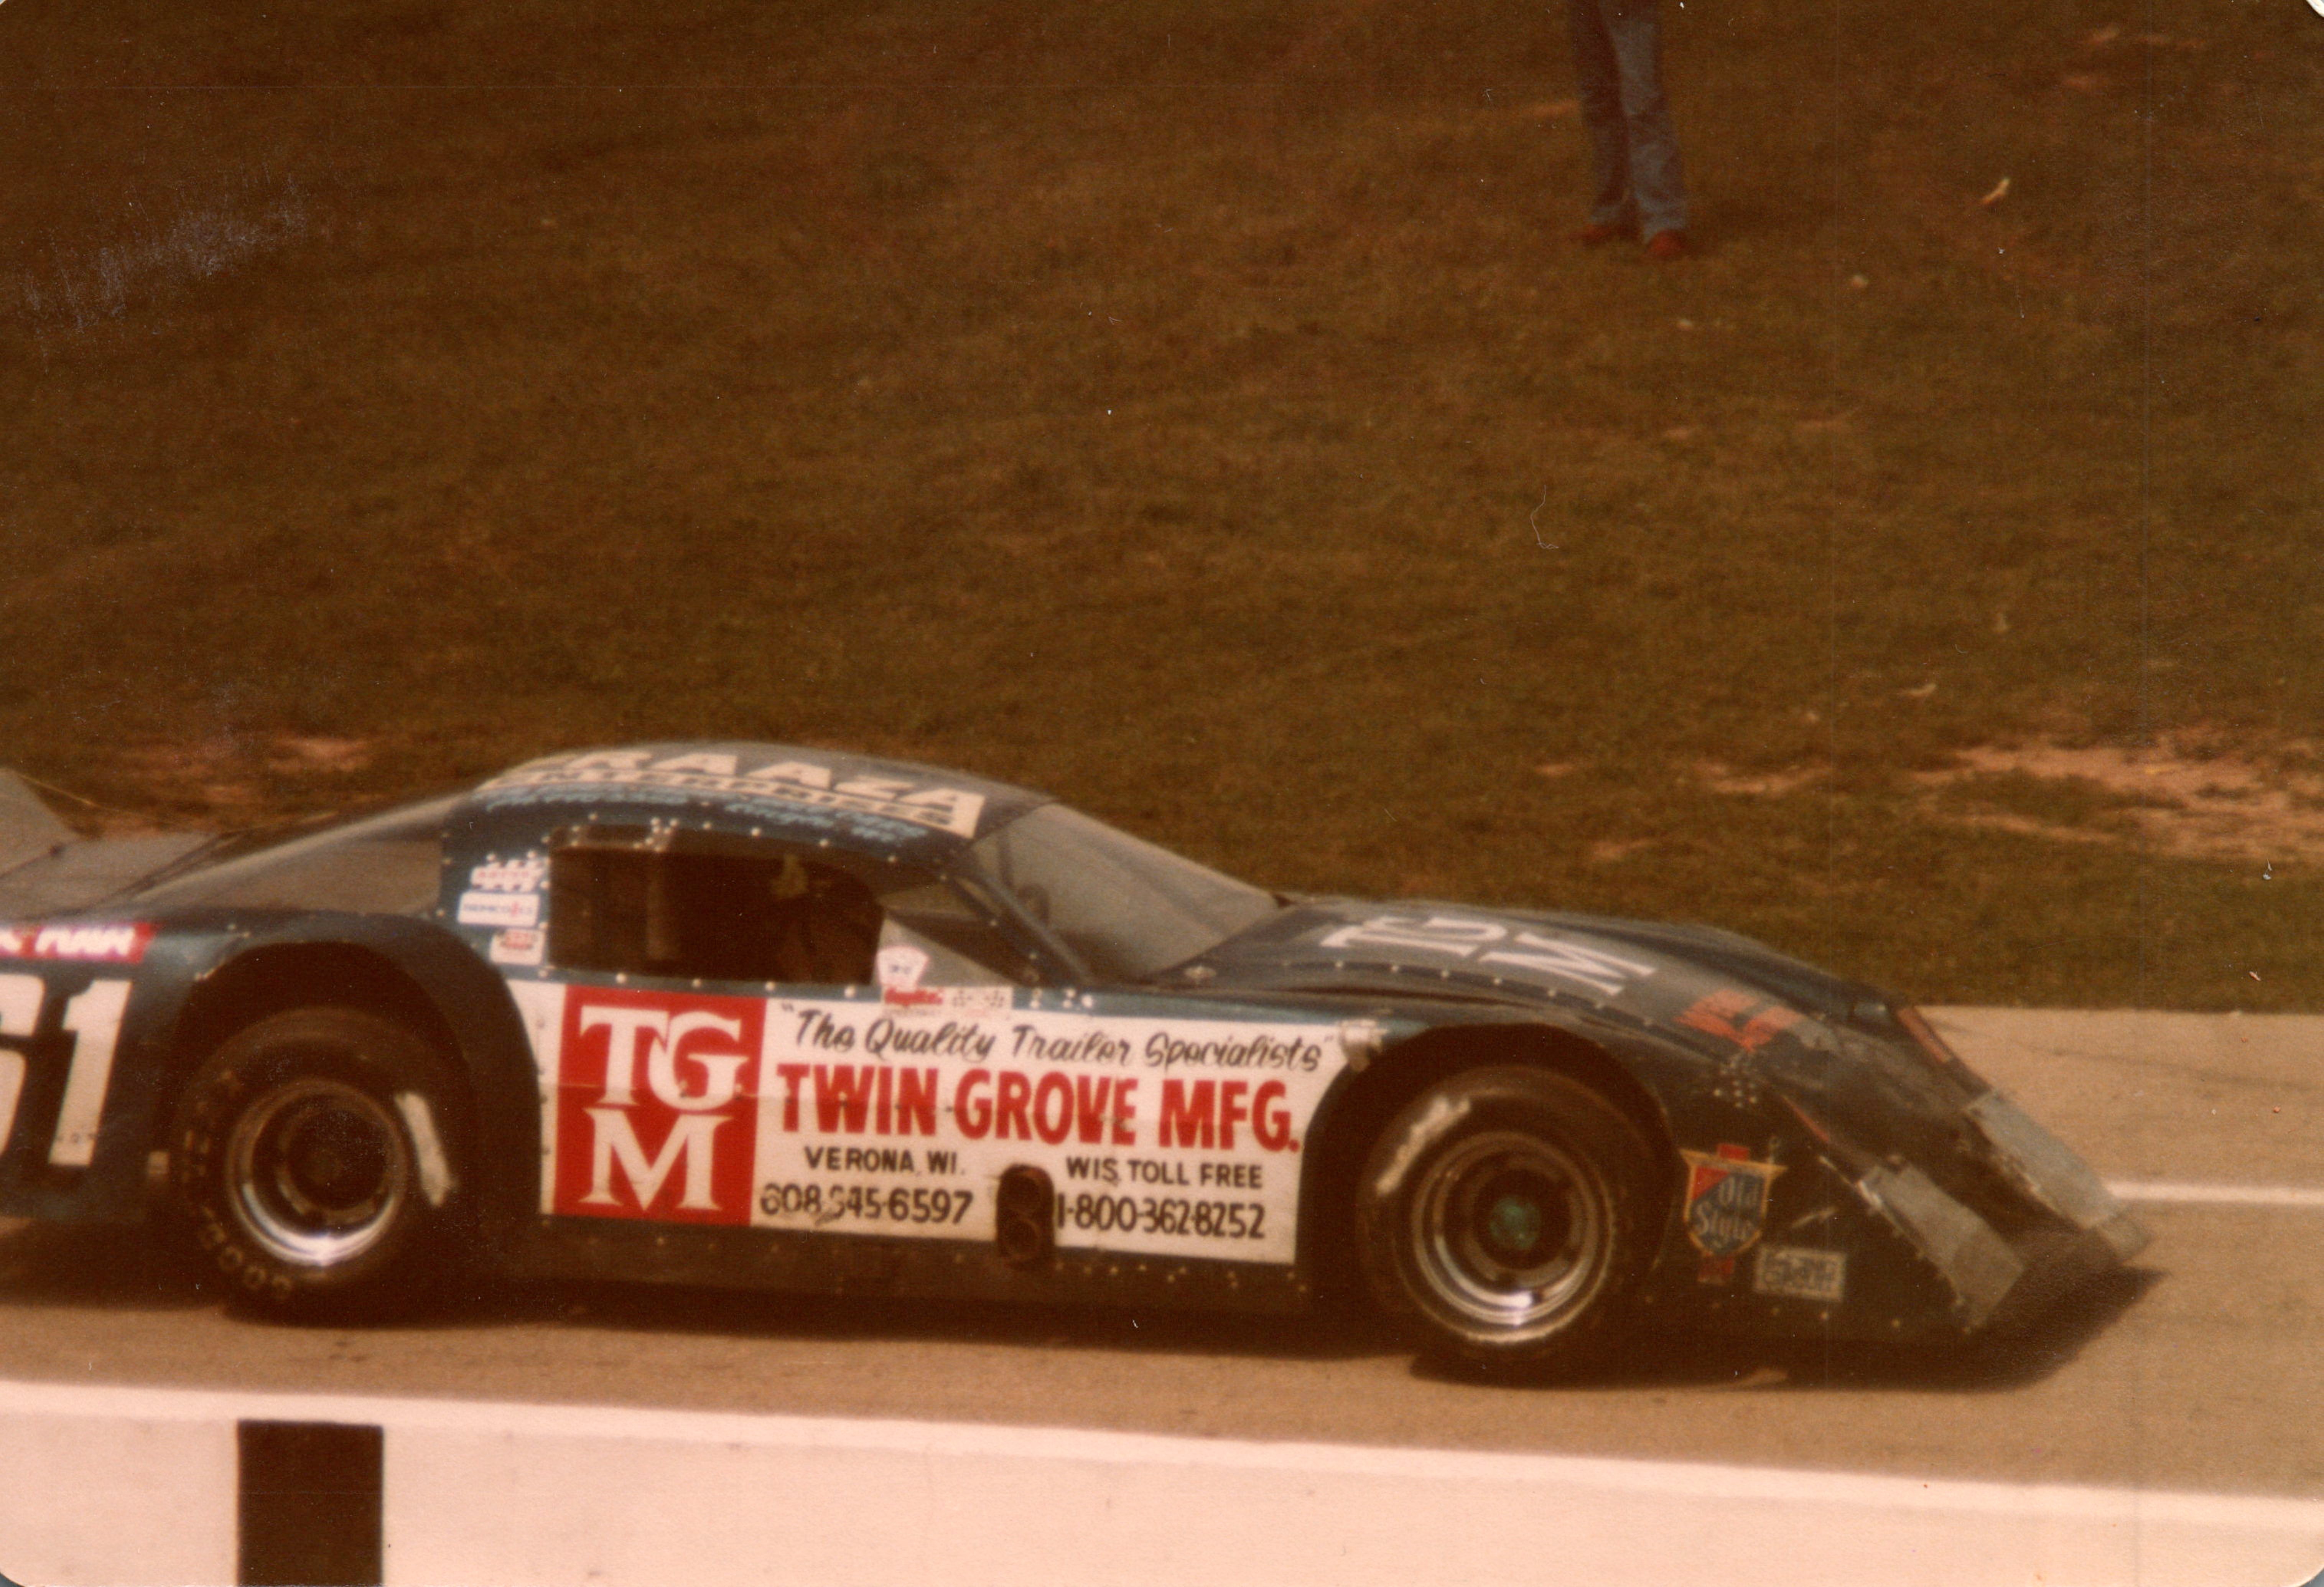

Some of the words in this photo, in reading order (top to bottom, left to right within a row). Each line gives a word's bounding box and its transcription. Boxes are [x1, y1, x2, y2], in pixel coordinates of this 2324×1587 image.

[864, 1017, 997, 1062] Quality
[1012, 1024, 1131, 1066] Trailer
[777, 1063, 939, 1136] TWIN
[954, 1068, 1138, 1145] GROVE
[1159, 1078, 1300, 1152] MFG.
[1127, 1159, 1191, 1186] TOLL
[1199, 1162, 1263, 1189] FREE
